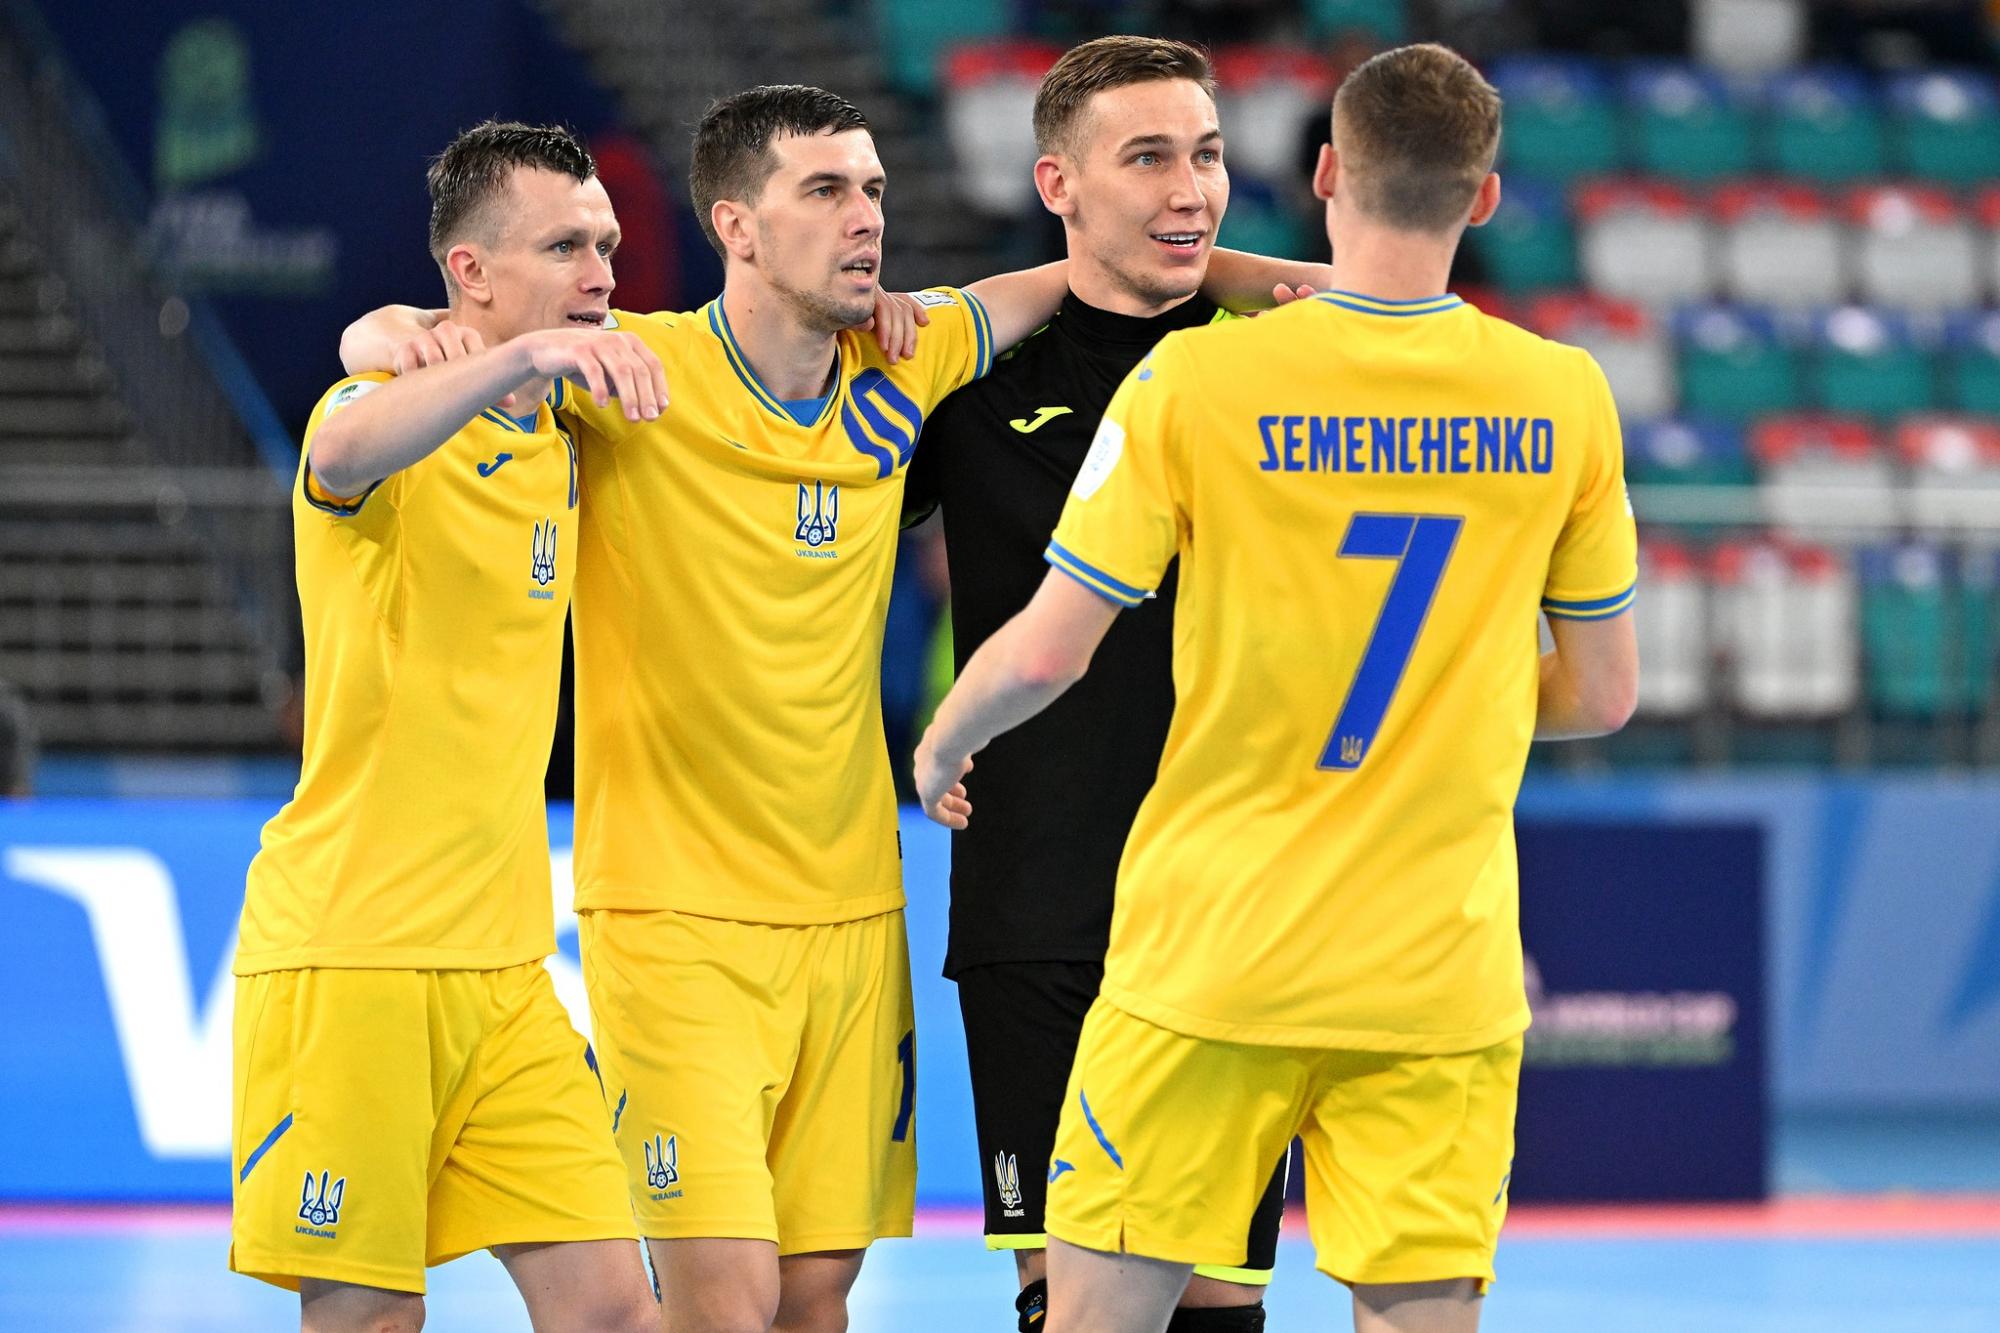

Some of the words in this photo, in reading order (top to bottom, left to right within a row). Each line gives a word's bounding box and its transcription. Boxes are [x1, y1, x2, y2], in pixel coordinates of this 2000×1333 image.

[1257, 415, 1554, 475] SEMENCHENKO
[795, 548, 838, 559] UKRAINE
[1315, 511, 1466, 772] 7
[295, 1225, 337, 1240] UKRAINE
